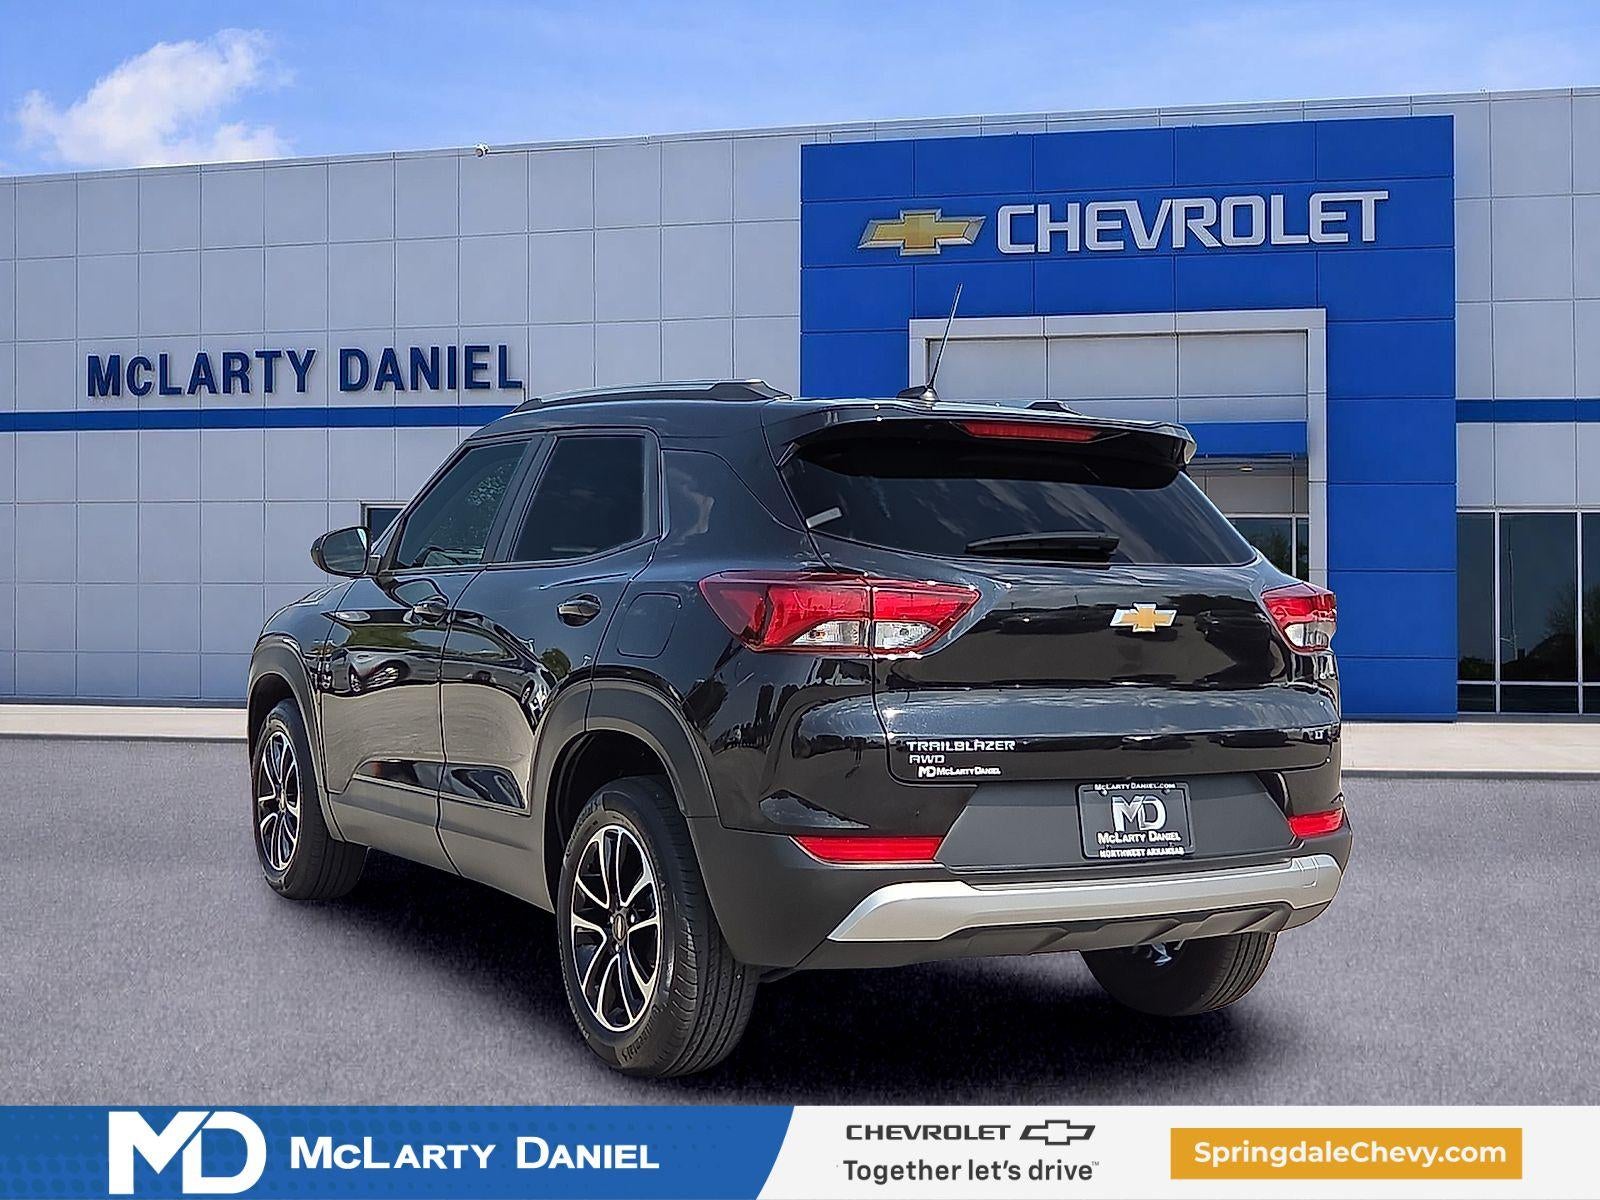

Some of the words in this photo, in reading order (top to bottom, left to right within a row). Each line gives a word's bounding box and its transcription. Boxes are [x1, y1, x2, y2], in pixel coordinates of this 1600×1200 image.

[997, 190, 1389, 254] CHEVROLET
[339, 345, 523, 392] DANIEL
[905, 740, 1016, 752] TRAILBLAZER
[909, 755, 945, 764] AWD
[1112, 795, 1167, 832] MD
[1148, 831, 1182, 842] DANIEL
